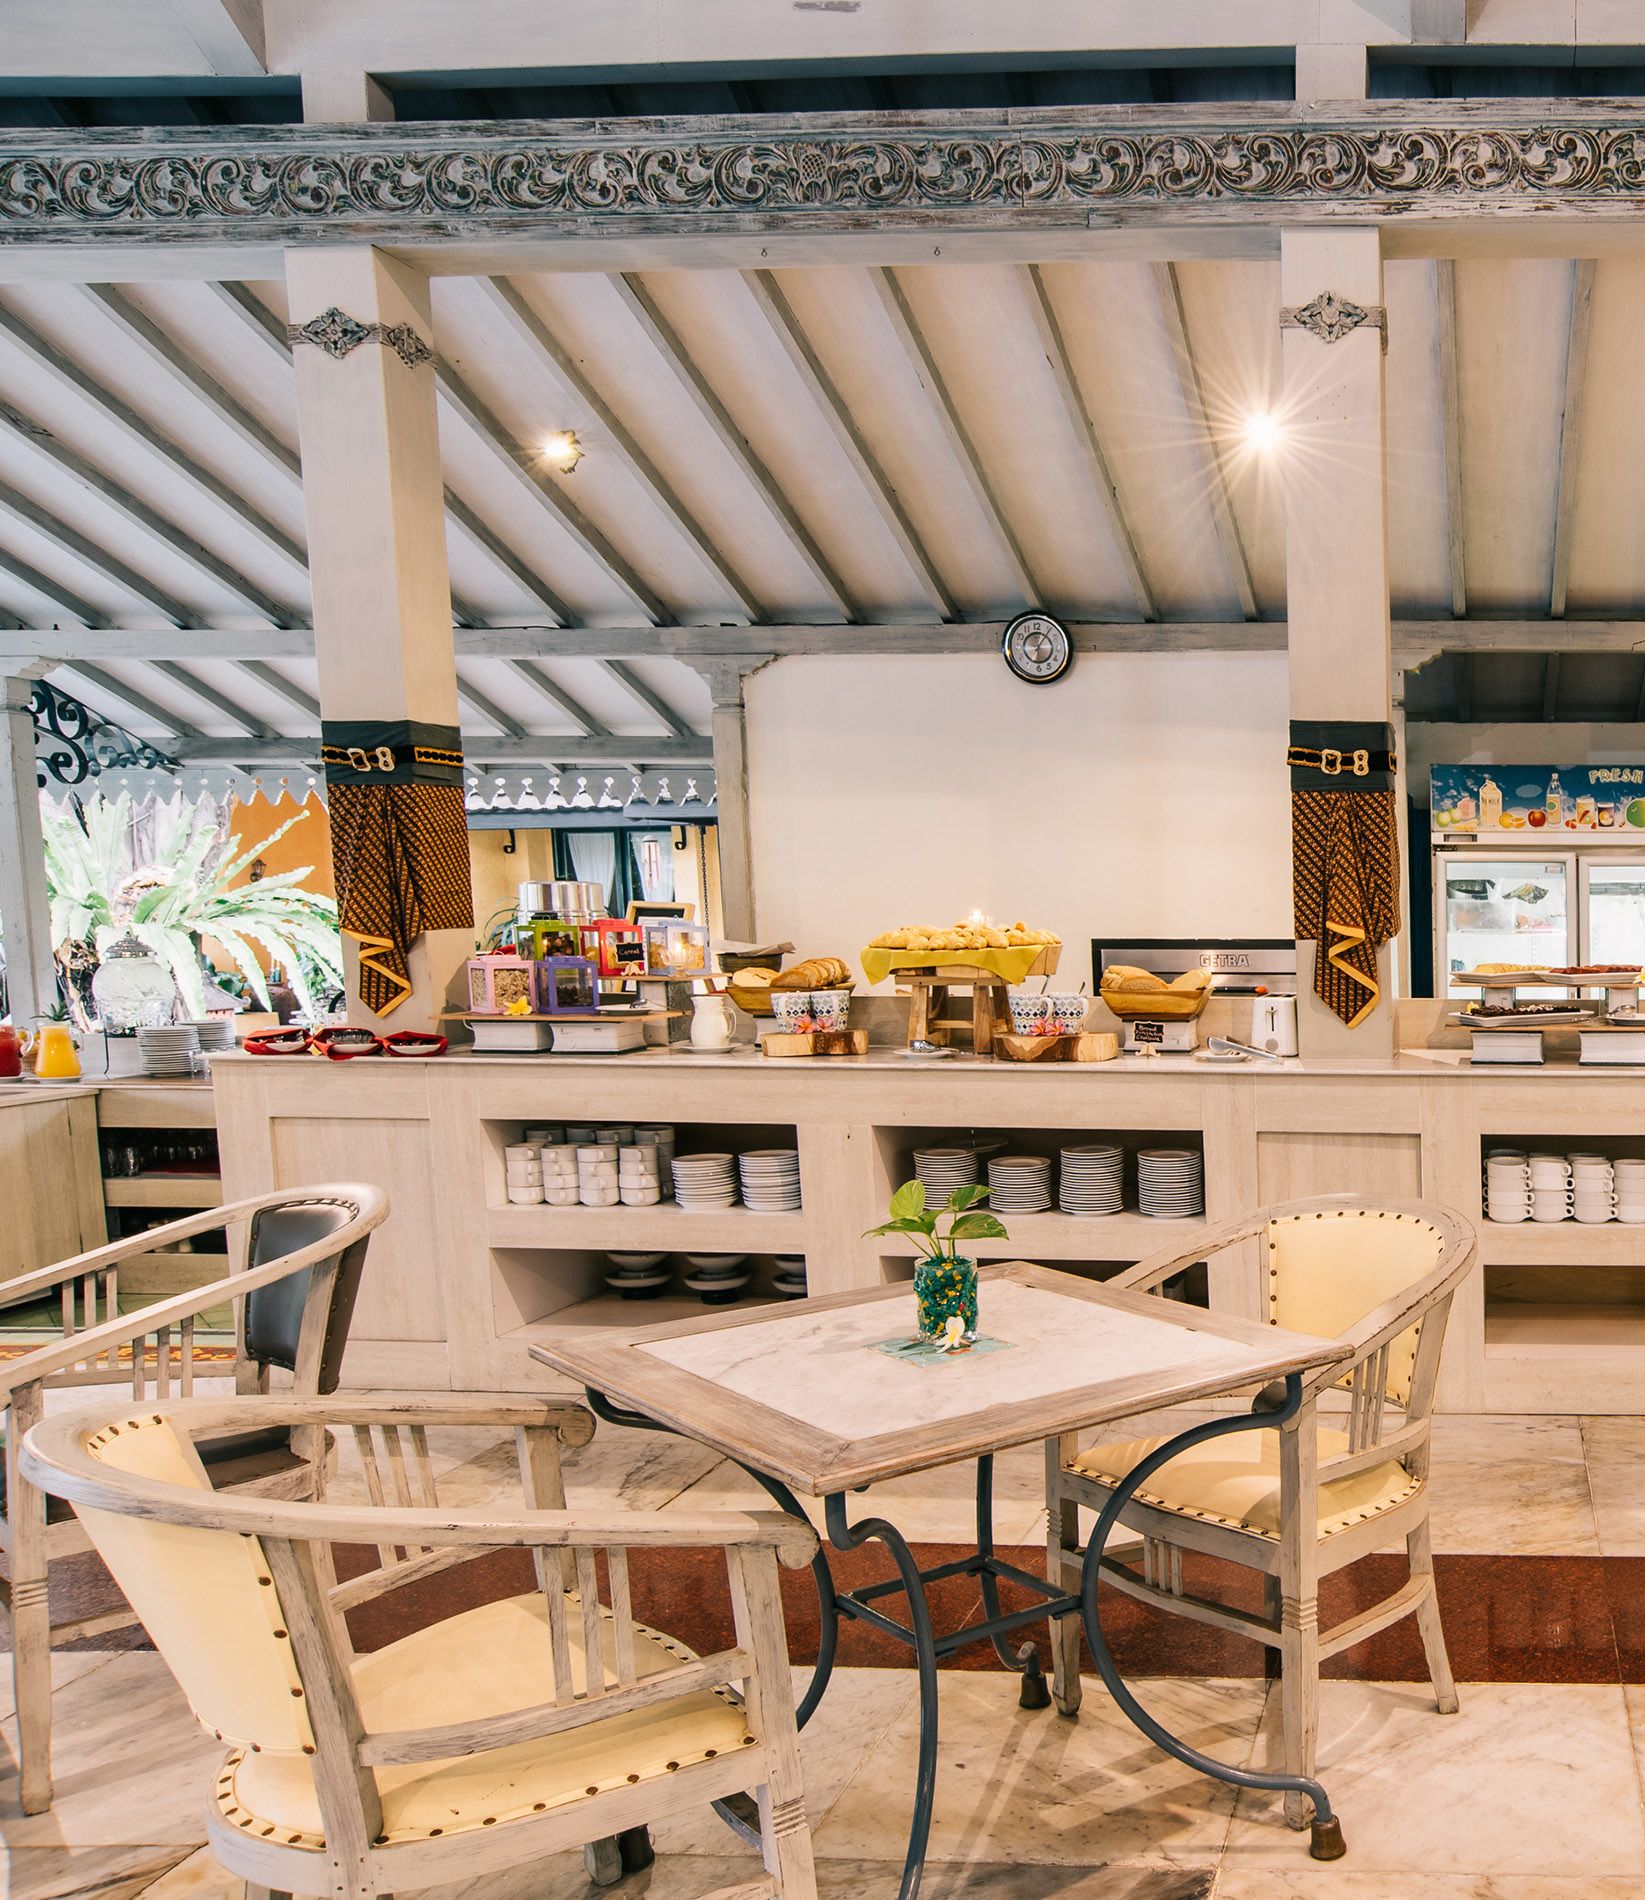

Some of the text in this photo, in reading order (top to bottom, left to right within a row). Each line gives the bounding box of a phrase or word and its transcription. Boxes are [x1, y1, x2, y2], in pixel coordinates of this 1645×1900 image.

[1024, 625, 1030, 633] 11
[1033, 622, 1041, 630] 12
[1036, 664, 1042, 672] 6
[1046, 662, 1052, 670] 5
[1588, 768, 1644, 784] FRESH
[1199, 953, 1250, 968] GETRA
